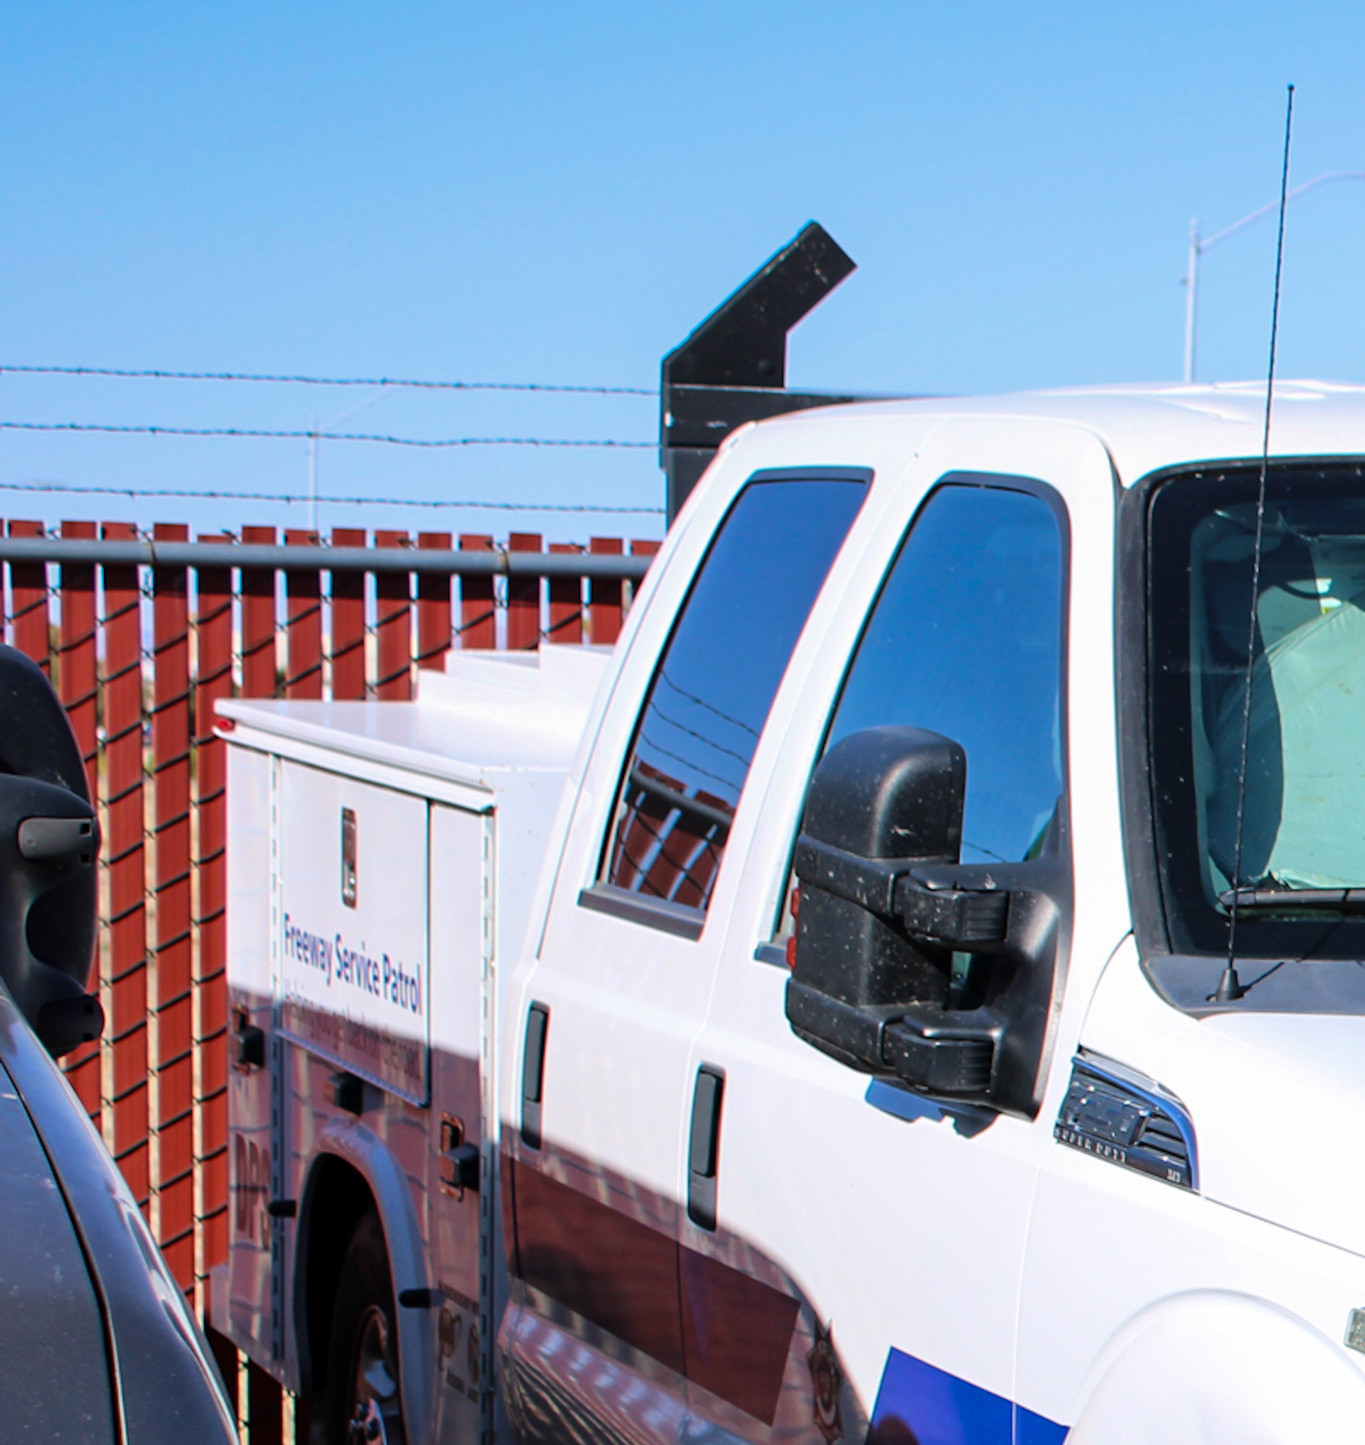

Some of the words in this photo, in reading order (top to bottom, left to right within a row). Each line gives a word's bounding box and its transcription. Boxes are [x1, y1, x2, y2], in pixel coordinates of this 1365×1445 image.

[283, 912, 333, 987] Freeway
[334, 932, 380, 997] Service
[382, 952, 423, 1016] Patrol
